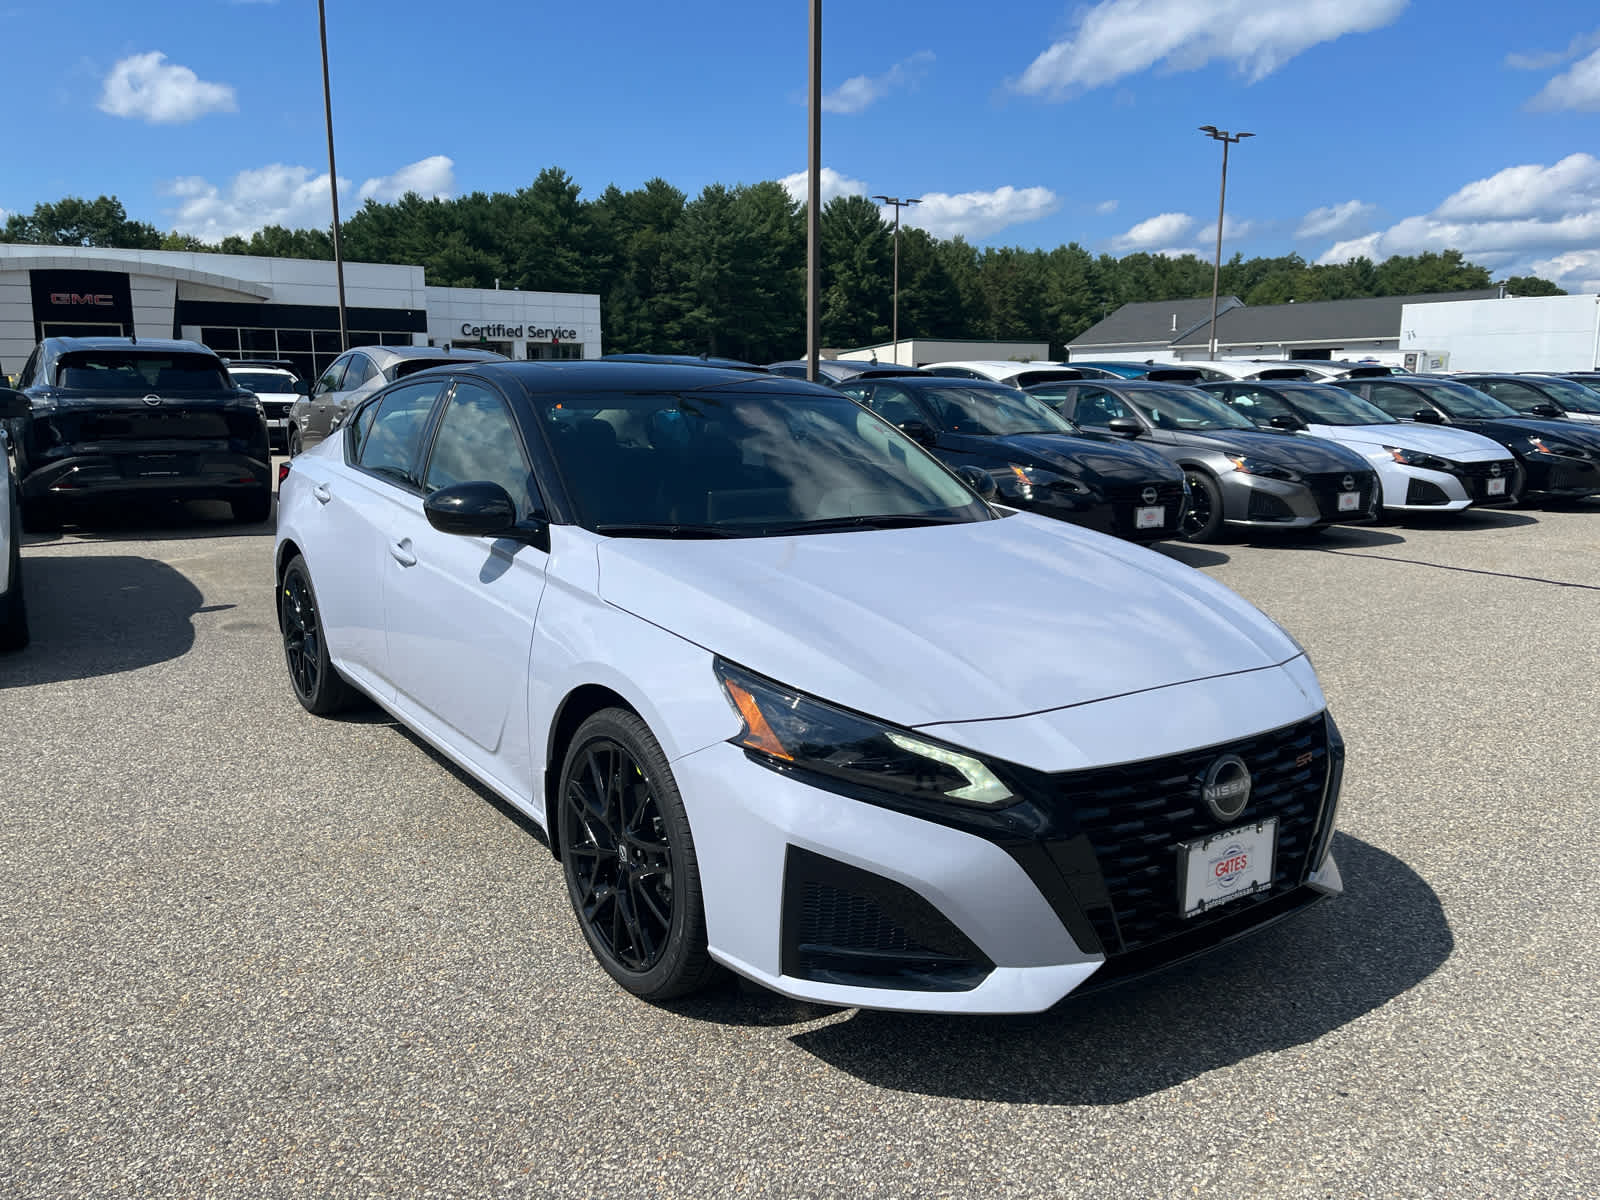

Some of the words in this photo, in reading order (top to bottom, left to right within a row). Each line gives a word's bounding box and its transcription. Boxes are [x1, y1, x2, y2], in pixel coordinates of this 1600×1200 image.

[51, 293, 113, 306] GMC
[461, 323, 523, 338] Certified
[528, 325, 577, 339] Service
[1296, 752, 1312, 767] SR
[1215, 854, 1247, 877] GATES
